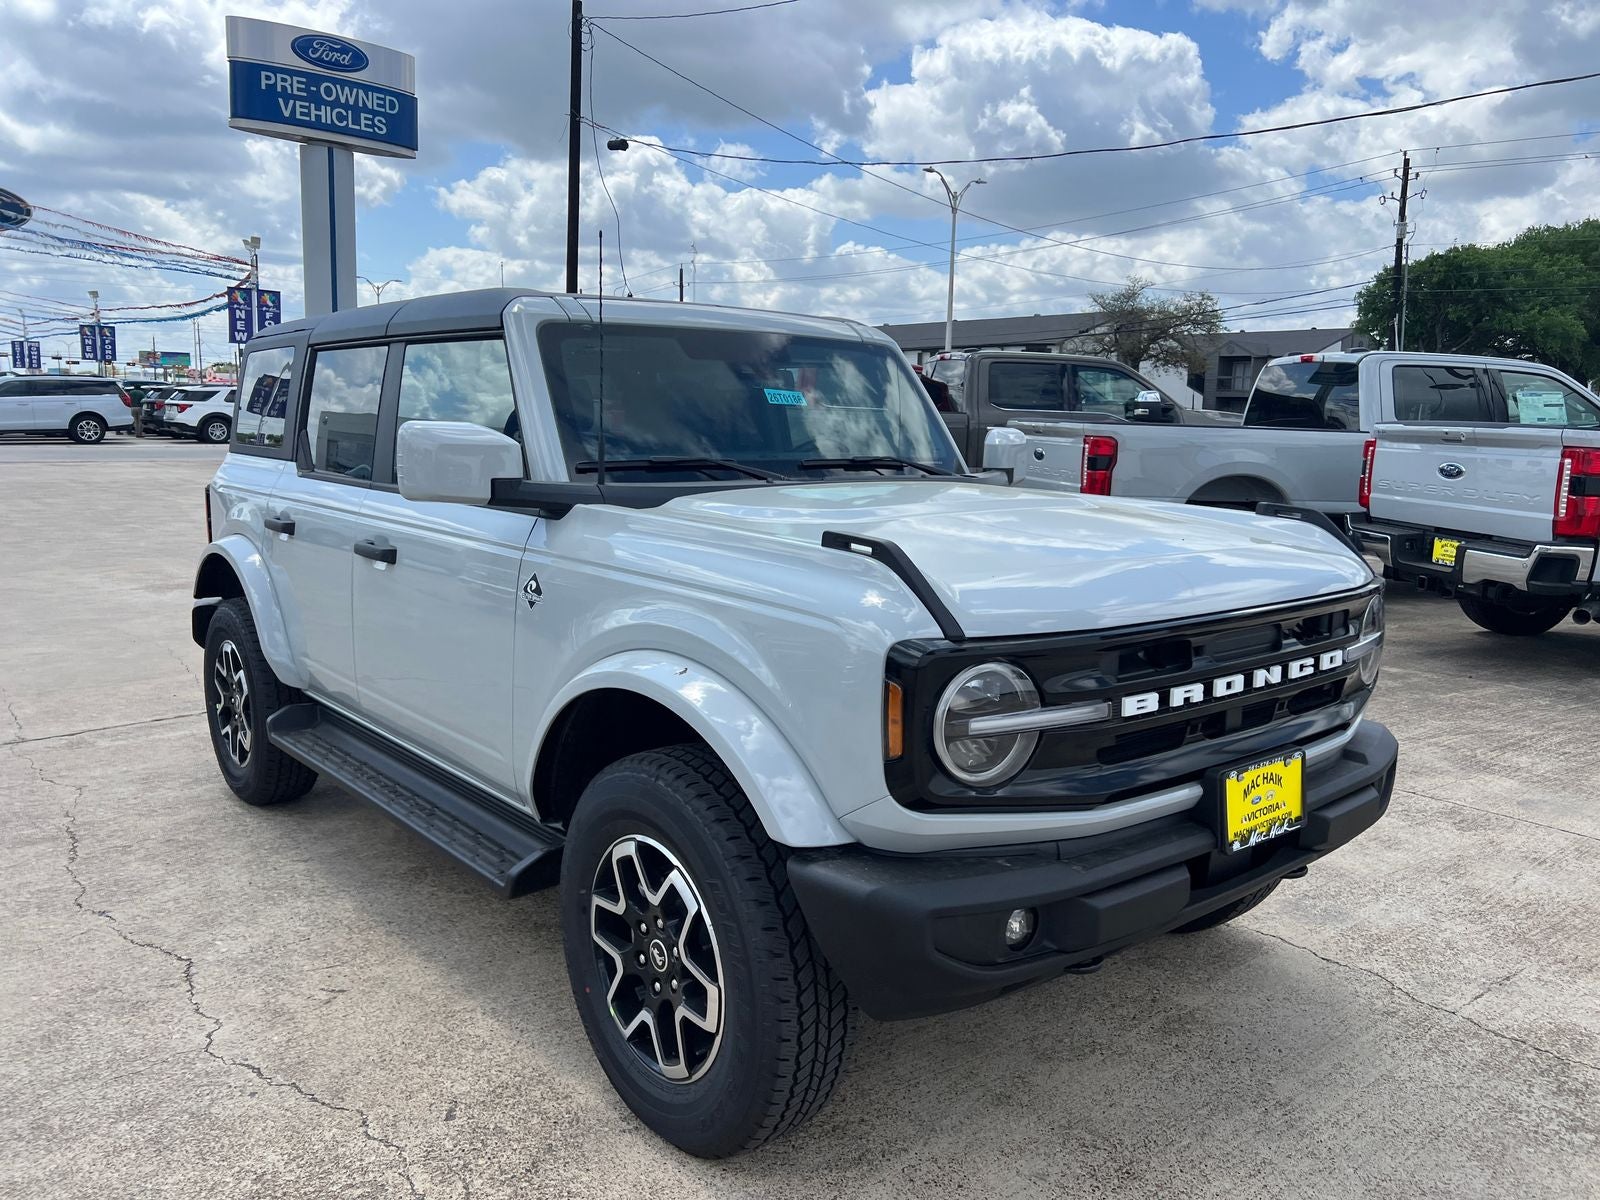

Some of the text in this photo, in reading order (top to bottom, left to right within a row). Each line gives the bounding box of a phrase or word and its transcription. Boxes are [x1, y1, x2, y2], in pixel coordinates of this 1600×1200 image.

[308, 39, 353, 66] Ford
[278, 98, 387, 135] VEHICLES
[234, 309, 248, 342] NEW
[30, 347, 38, 368] OWNED
[84, 339, 94, 359] NEW
[104, 340, 112, 360] FORD
[1377, 479, 1544, 505] SUPER DUTY
[1121, 649, 1343, 718] BRONCO
[1242, 774, 1261, 803] MAC
[1262, 771, 1284, 789] HAIK
[1246, 802, 1281, 823] VICTORIA
